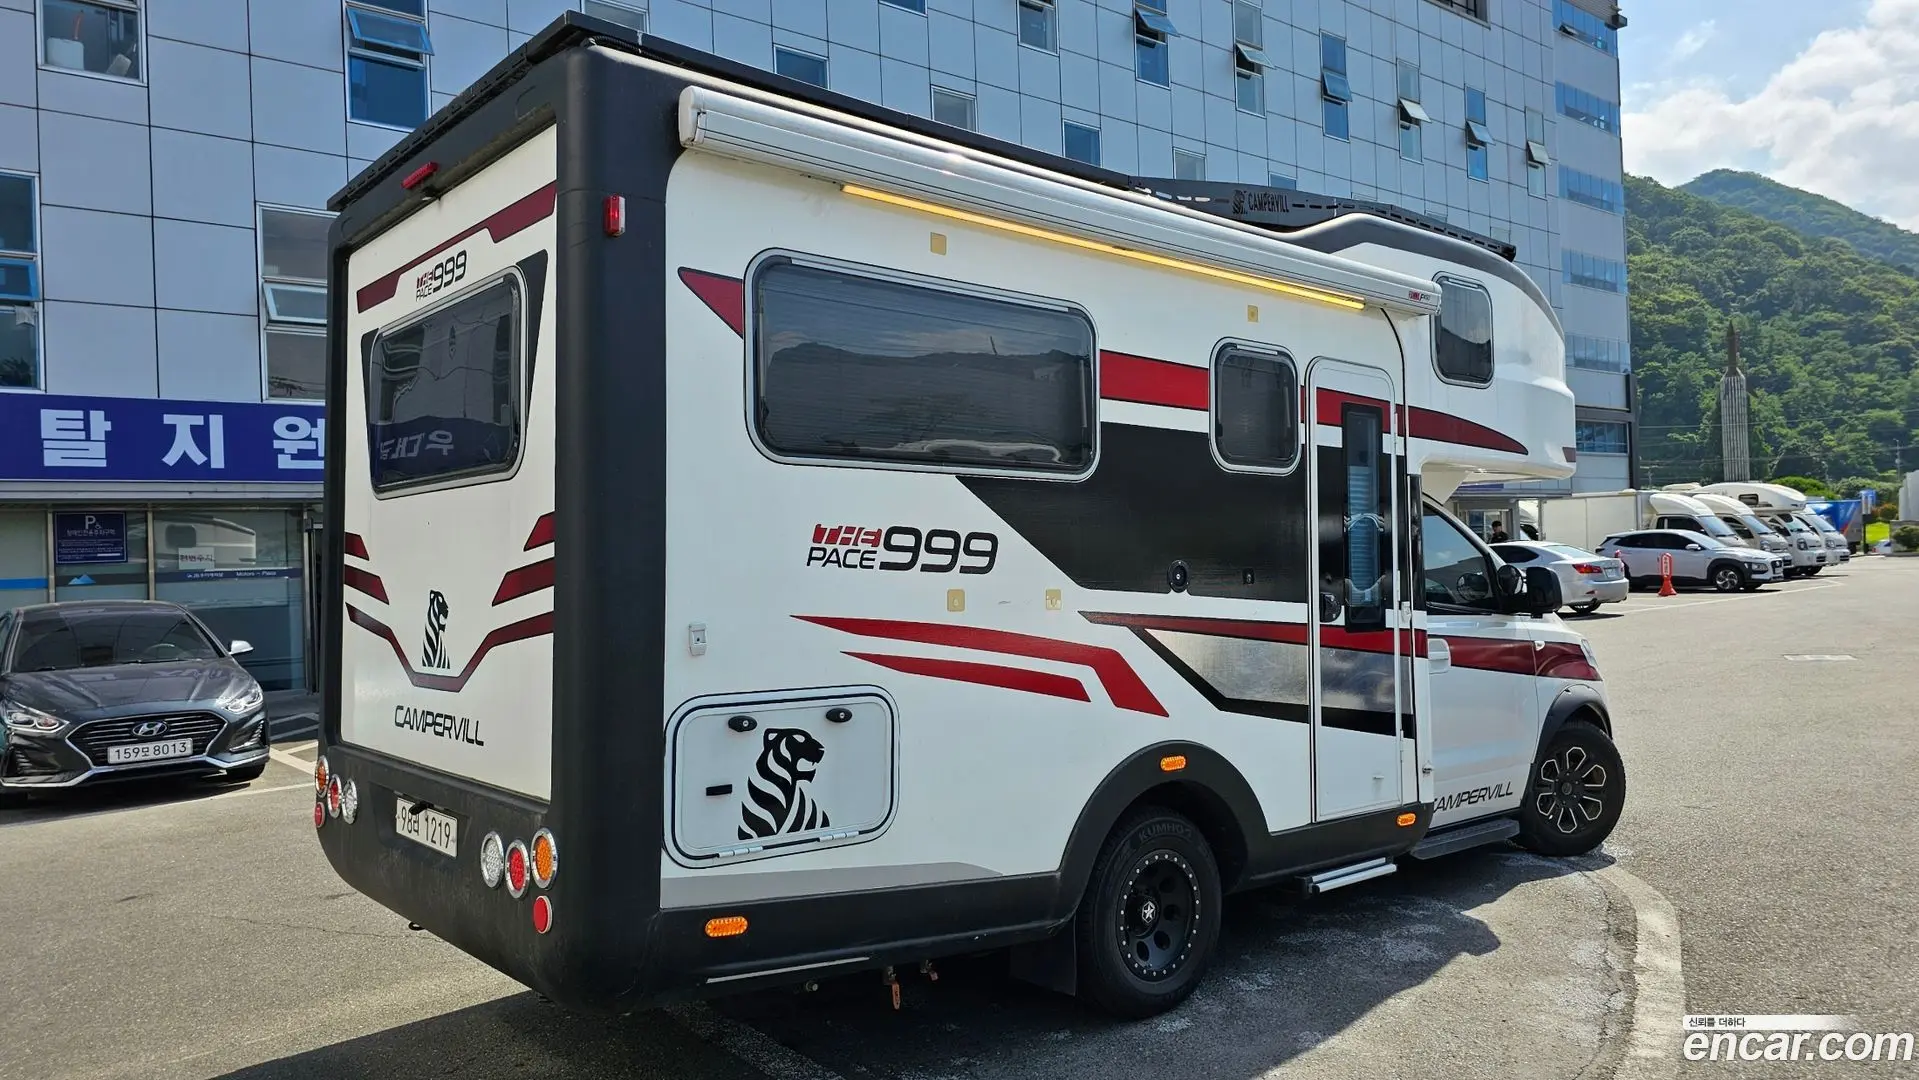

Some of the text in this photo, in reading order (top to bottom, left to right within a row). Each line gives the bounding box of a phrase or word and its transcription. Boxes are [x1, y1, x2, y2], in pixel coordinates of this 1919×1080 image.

[1248, 191, 1290, 213] CAMPERVILL
[433, 249, 467, 293] 999
[416, 283, 433, 302] PACE
[85, 515, 96, 529] P
[806, 546, 878, 570] PACE
[879, 526, 999, 575] 999
[394, 705, 484, 746] CAMPERVILL
[115, 742, 187, 760] 159모 8013
[1434, 781, 1513, 813] AMPERVILL
[425, 815, 451, 848] 1219
